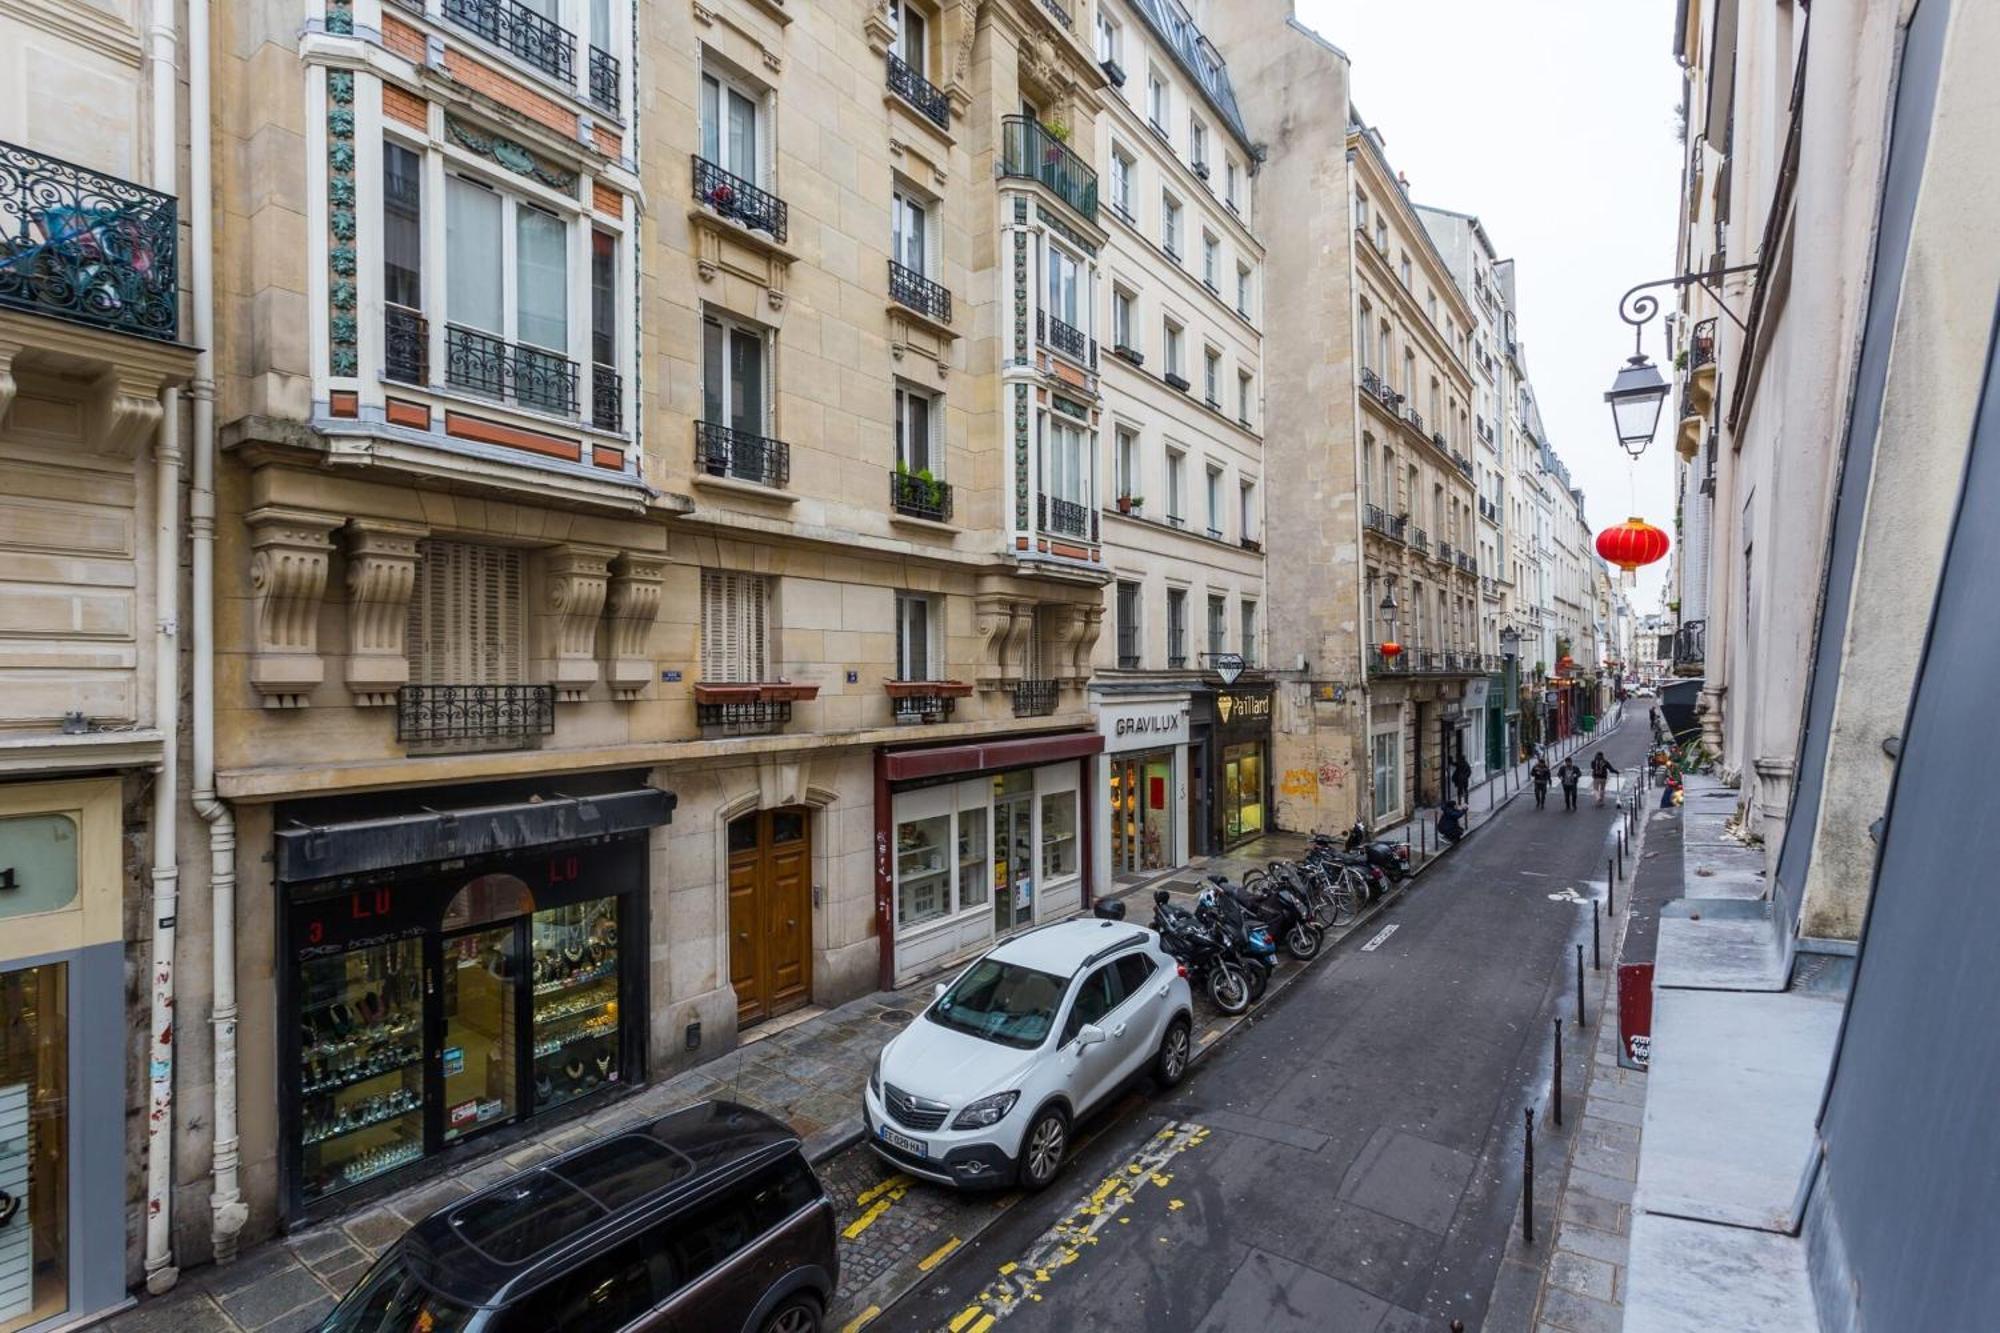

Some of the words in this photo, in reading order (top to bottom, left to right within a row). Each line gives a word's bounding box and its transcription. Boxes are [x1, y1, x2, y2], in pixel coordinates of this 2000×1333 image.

[1233, 695, 1269, 716] Paillard
[1116, 714, 1178, 736] GRAVILUX
[352, 887, 390, 917] LU
[310, 922, 323, 943] 3
